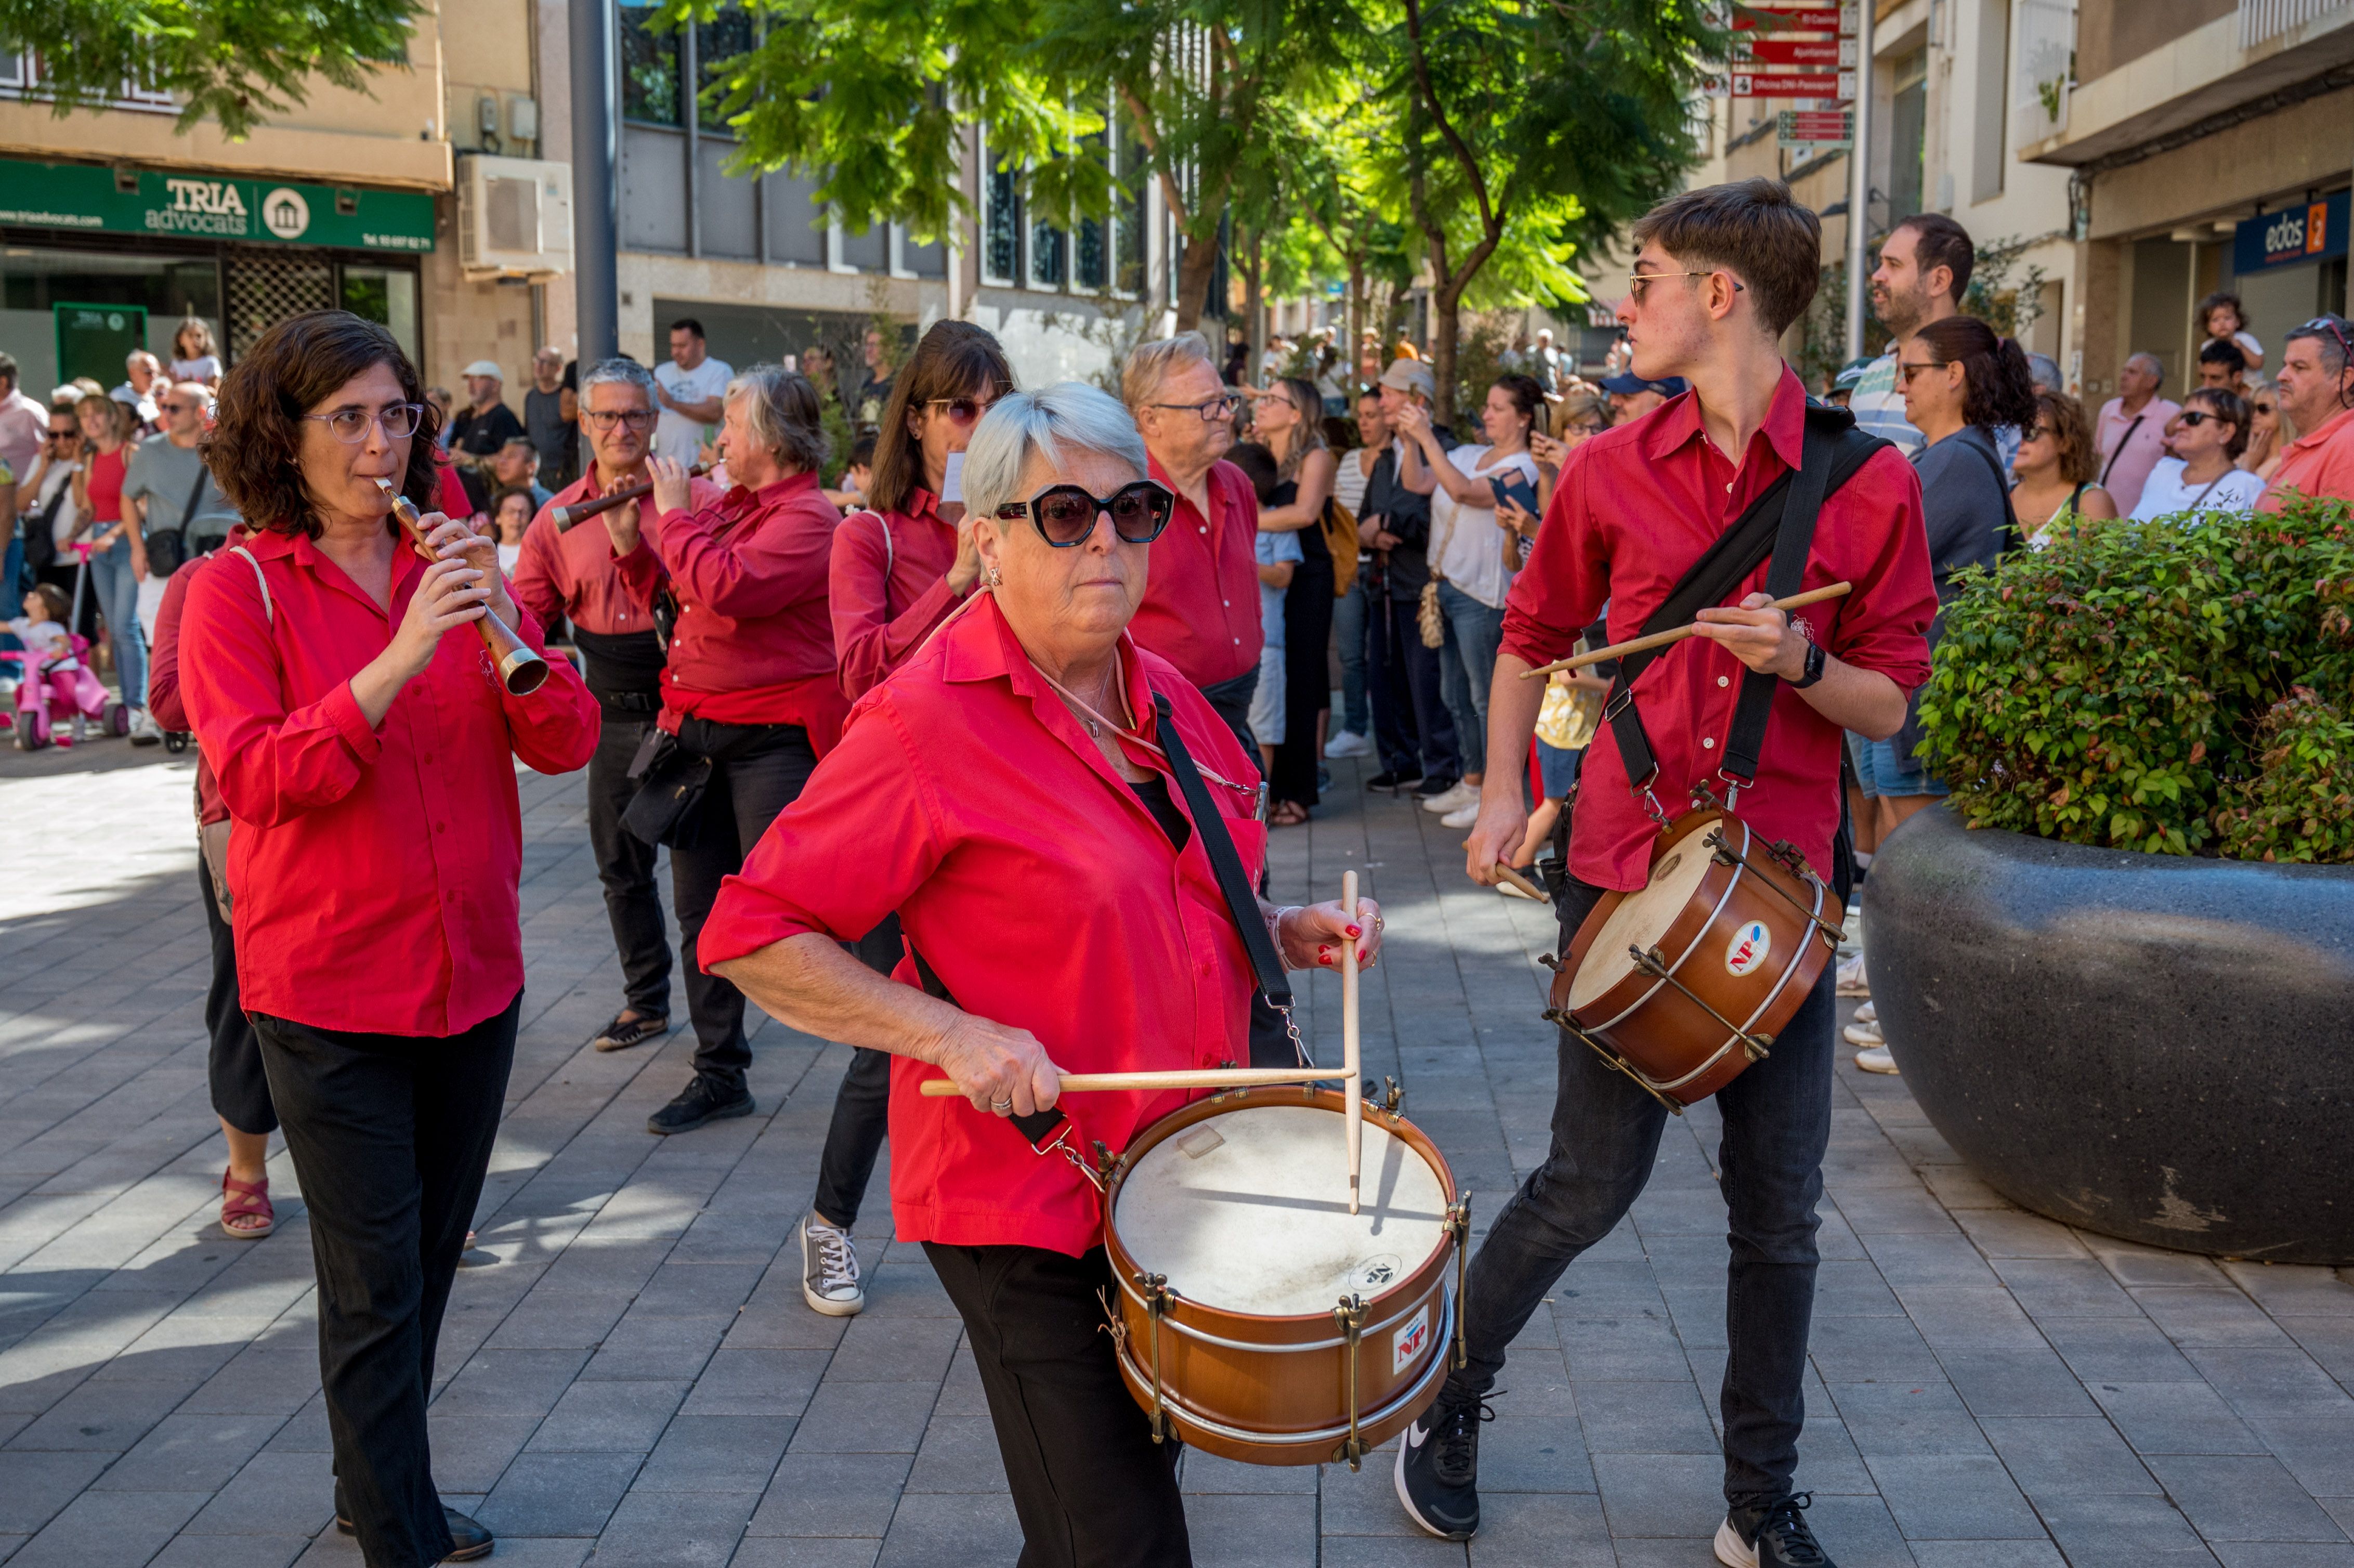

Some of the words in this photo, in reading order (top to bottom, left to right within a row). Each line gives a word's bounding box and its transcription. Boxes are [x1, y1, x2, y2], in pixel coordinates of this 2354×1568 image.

[1812, 14, 1839, 25] Casino
[1754, 79, 1780, 90] Oficina
[166, 178, 247, 216] TRIA
[145, 203, 247, 236] advocats
[2265, 212, 2304, 253] edos
[1730, 940, 1755, 972] NP
[1397, 1324, 1426, 1364] NP
